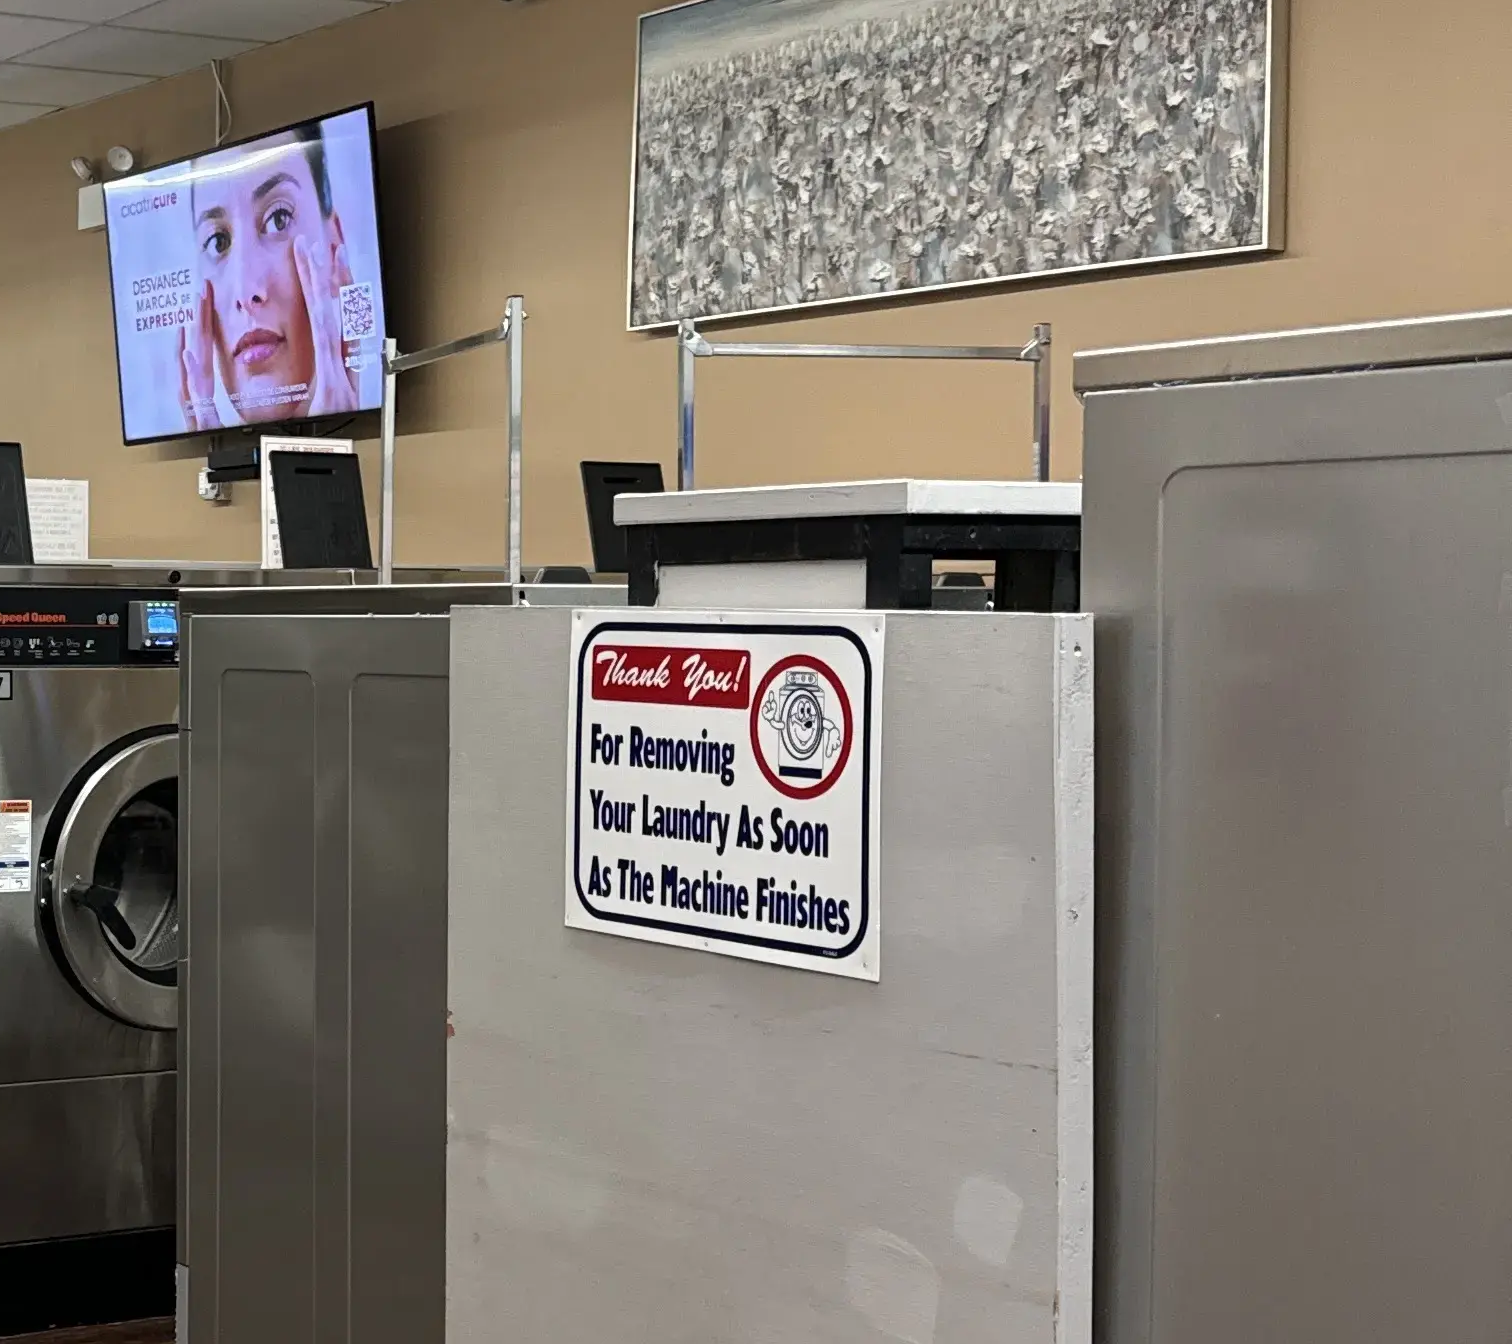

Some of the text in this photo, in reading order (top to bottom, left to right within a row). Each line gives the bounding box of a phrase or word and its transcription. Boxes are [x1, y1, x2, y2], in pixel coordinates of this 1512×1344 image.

[121, 191, 177, 218] cicatricure
[132, 269, 191, 296] DESVANECE
[136, 292, 192, 313] MARCAS DE
[136, 307, 194, 332] EXPRESIÓN
[31, 612, 67, 623] Queen
[595, 650, 747, 701] Thank You!
[590, 723, 735, 786] For Removing
[590, 789, 829, 858] Your Laundry As Soon
[588, 855, 850, 935] As The Machine Finishes
